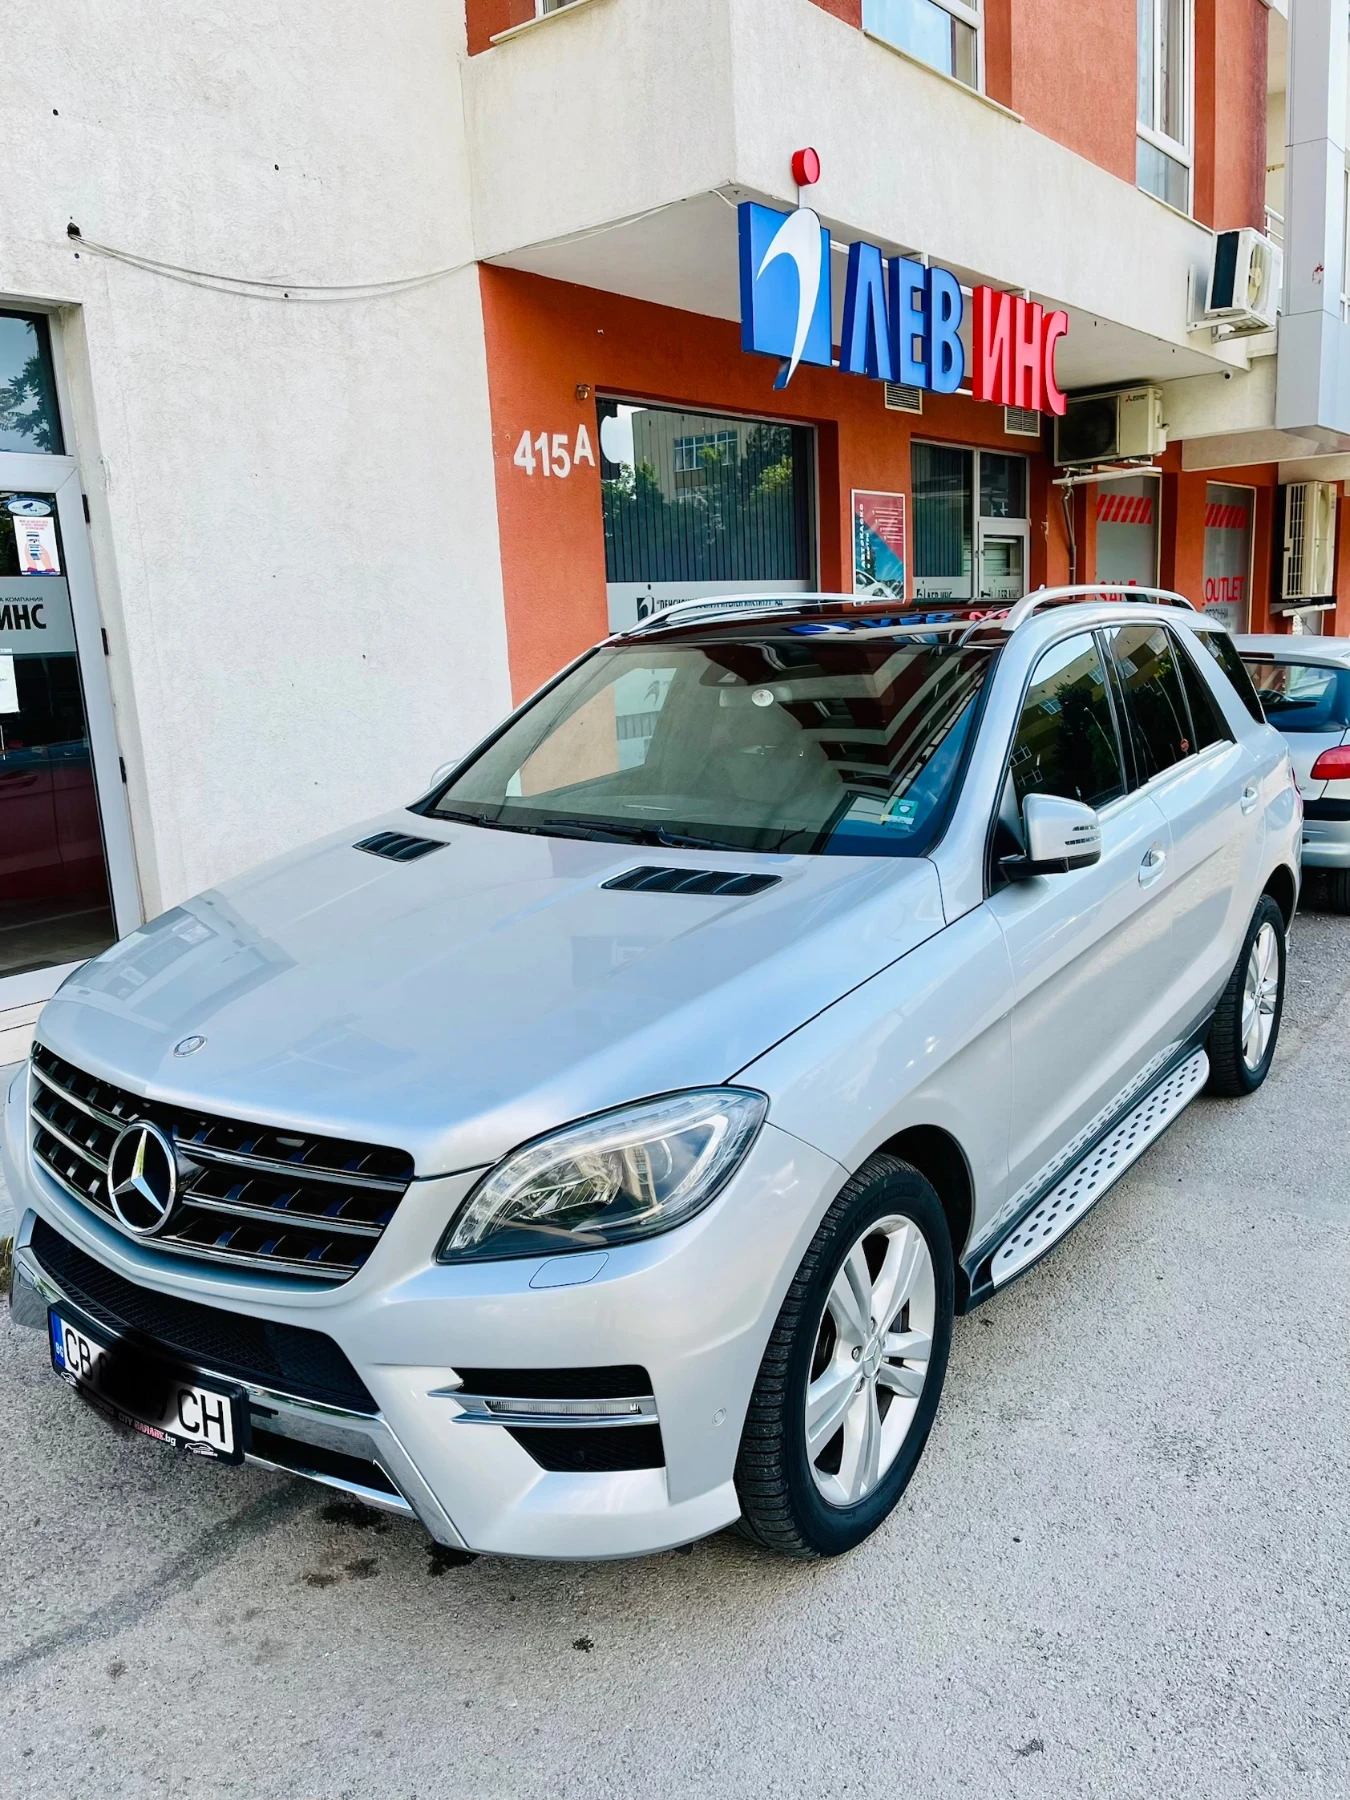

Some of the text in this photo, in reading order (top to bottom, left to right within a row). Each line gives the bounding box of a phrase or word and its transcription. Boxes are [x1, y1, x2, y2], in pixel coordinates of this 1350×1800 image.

[839, 240, 1068, 417] ЛЕВ ИНС
[1205, 576, 1244, 603] OUTLET
[55, 1341, 64, 1358] BG
